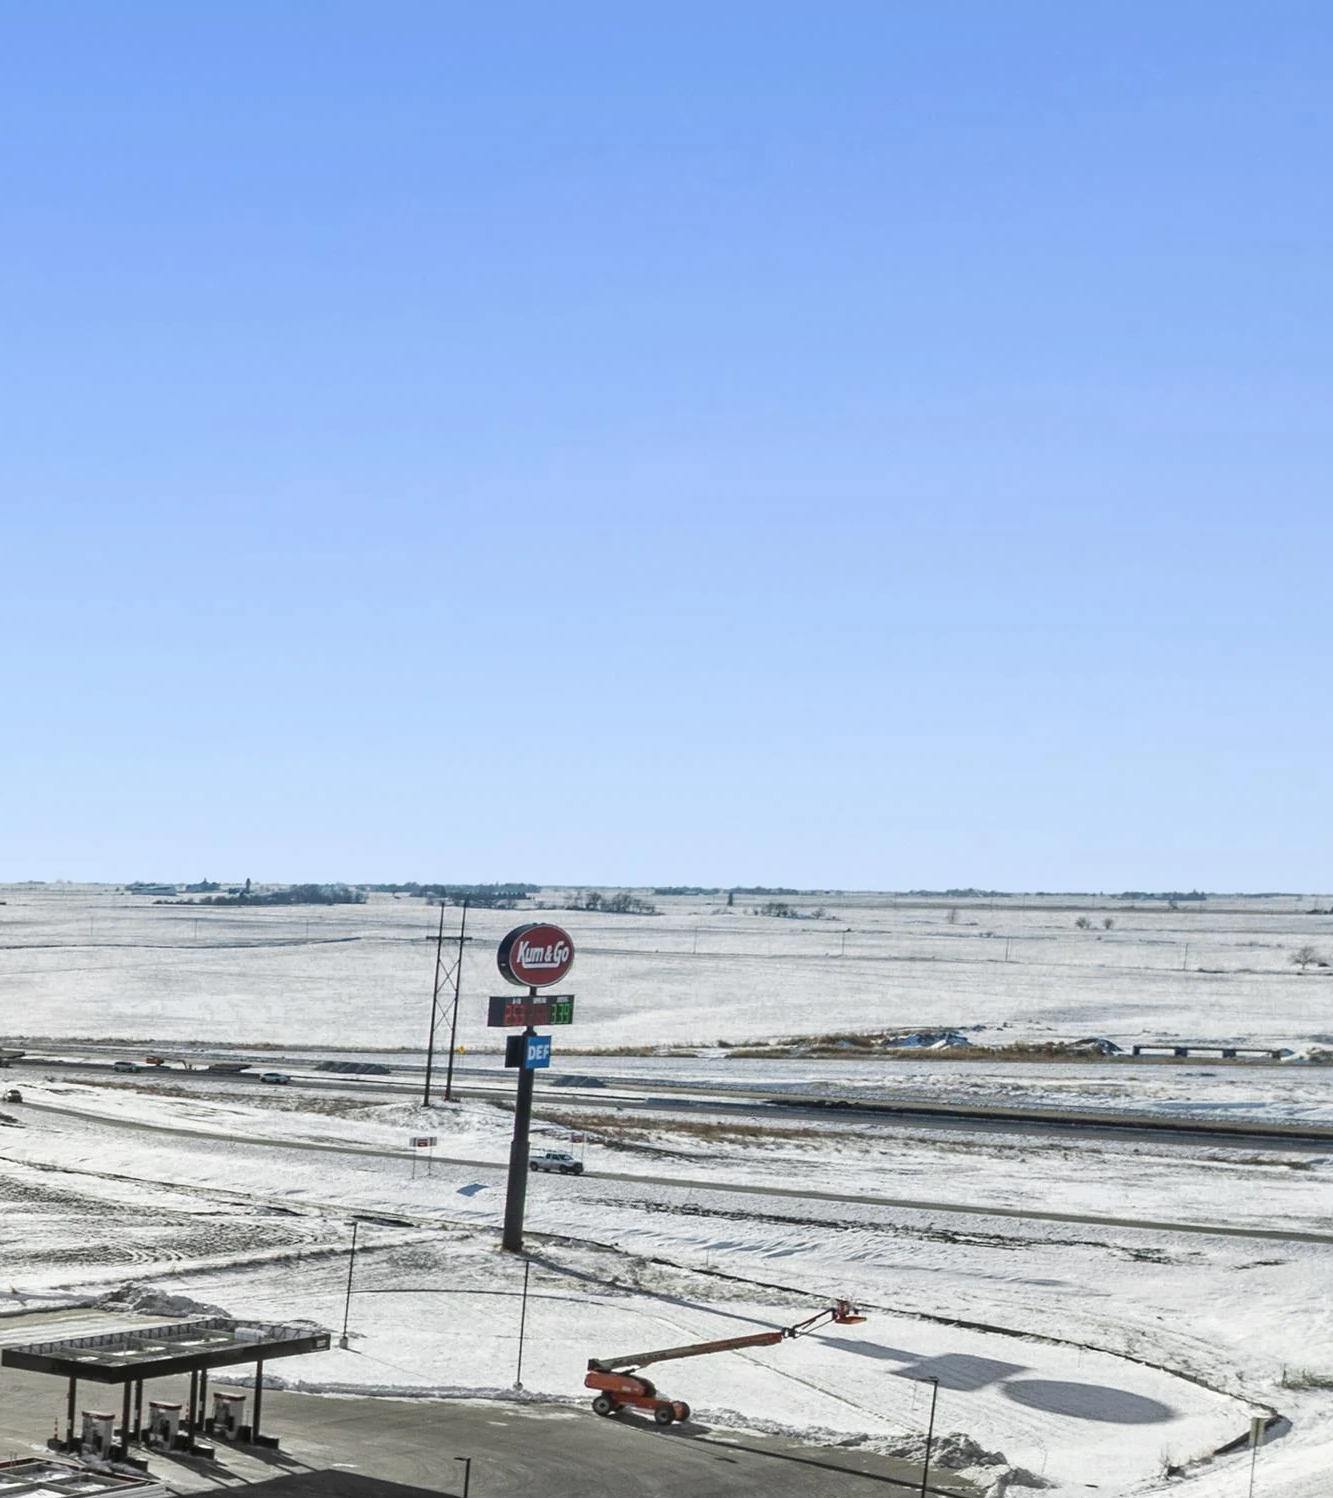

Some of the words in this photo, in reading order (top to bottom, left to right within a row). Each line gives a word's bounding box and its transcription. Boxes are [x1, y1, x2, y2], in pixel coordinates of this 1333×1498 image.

[517, 941, 544, 966] Kum
[545, 945, 552, 962] &
[553, 941, 570, 967] Go
[528, 1045, 549, 1060] DEF
